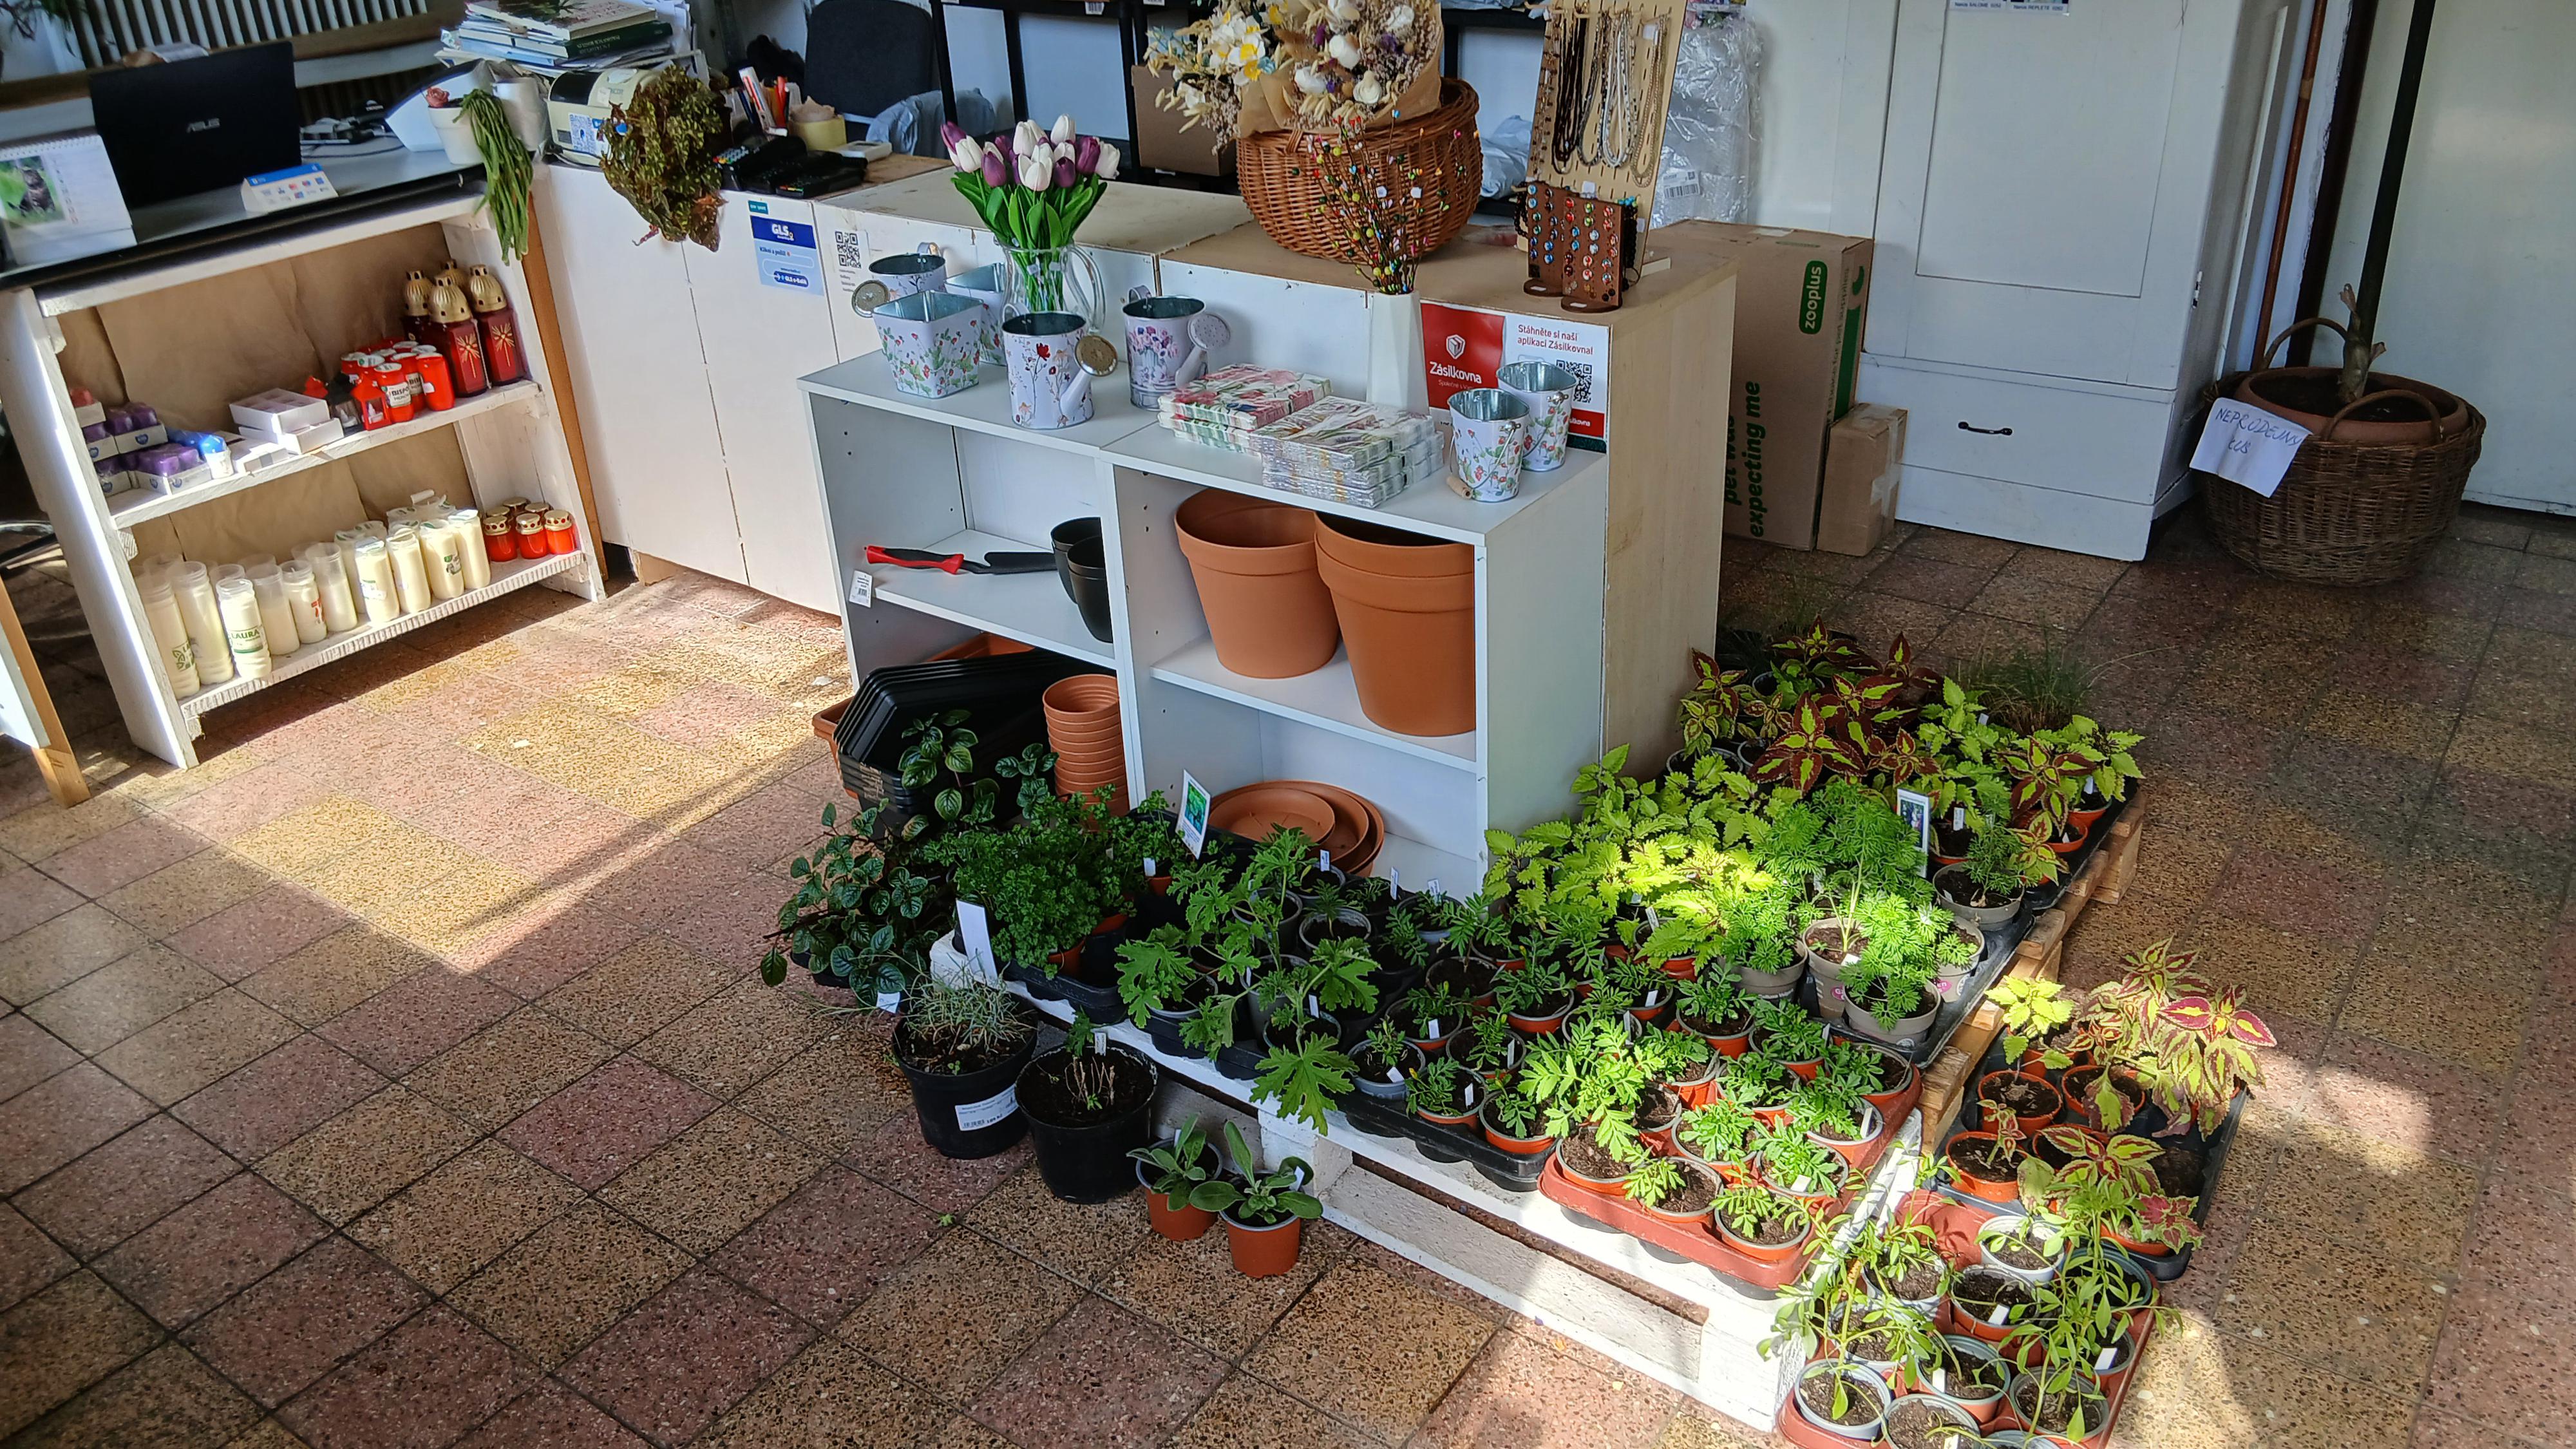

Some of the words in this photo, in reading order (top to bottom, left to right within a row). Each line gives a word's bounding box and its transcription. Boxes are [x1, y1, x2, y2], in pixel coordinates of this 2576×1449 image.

[187, 118, 220, 134] ASUS
[772, 223, 789, 237] GLS
[1805, 266, 1822, 330] zooplus
[1518, 324, 1552, 337] Stáhněte
[1553, 330, 1560, 339] si
[1517, 336, 1547, 348] aplikaci
[1548, 339, 1594, 355] Zásilkovna!
[1430, 361, 1482, 384] Zásilkovna
[1745, 381, 1761, 418] me
[1742, 422, 1768, 538] expecting
[231, 629, 260, 640] LAURA
